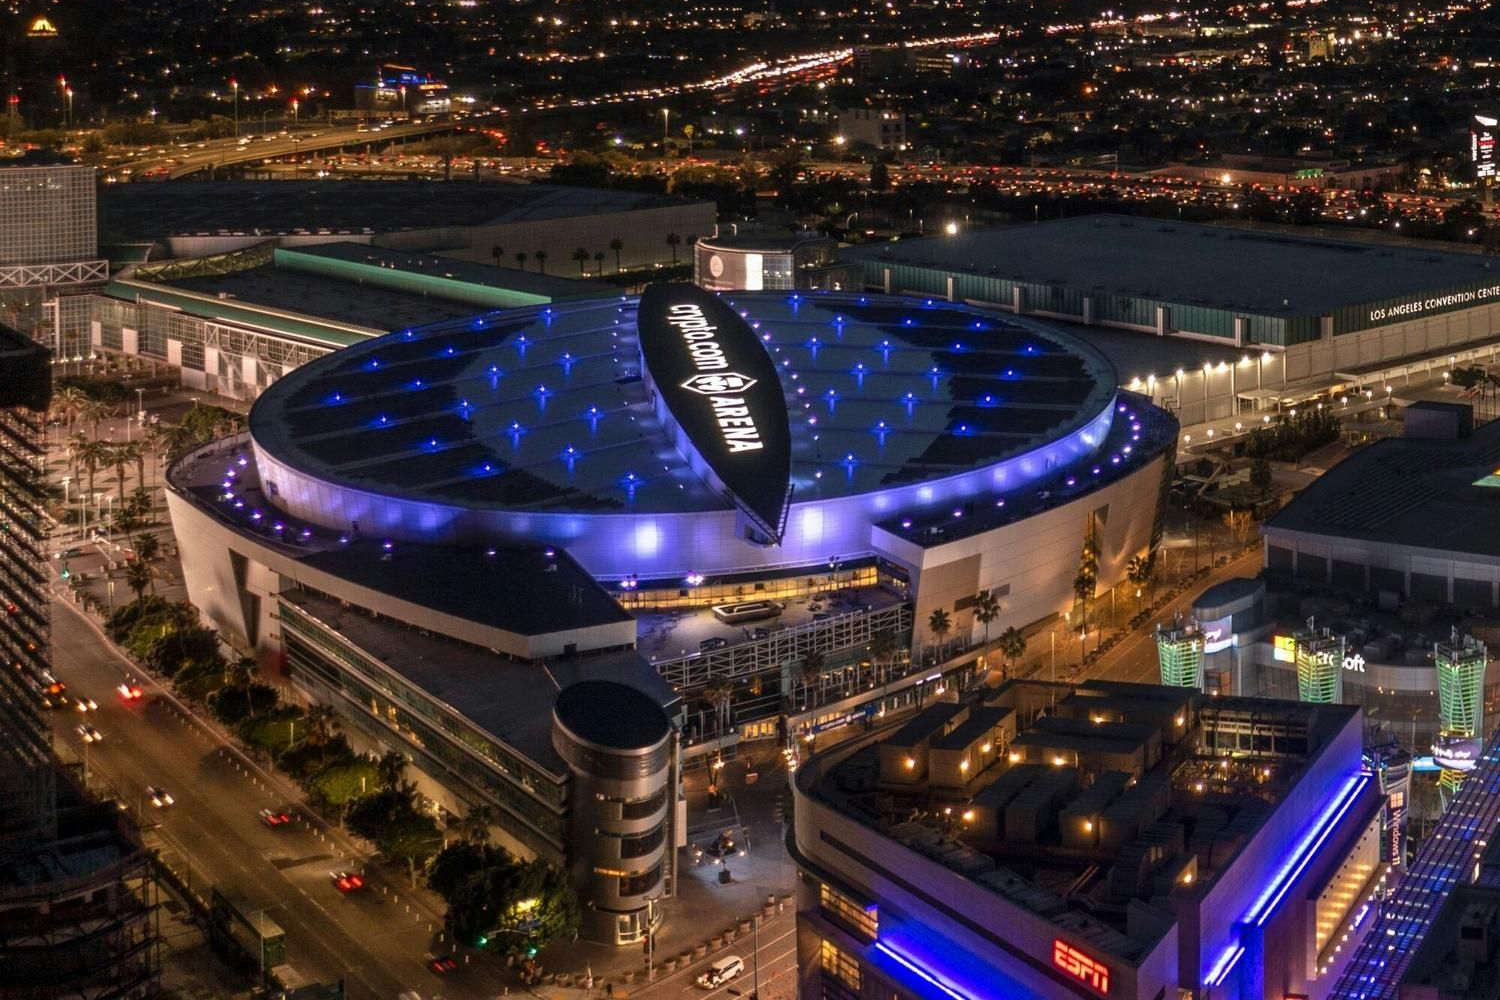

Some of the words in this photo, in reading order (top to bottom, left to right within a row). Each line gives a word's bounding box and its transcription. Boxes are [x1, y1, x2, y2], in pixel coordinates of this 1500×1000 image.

[1370, 309, 1385, 321] LOS
[1387, 301, 1423, 317] ANGELES
[1424, 290, 1475, 310] CONVENTION
[668, 304, 728, 370] crypto.com
[709, 396, 764, 452] ARENA
[1392, 809, 1401, 858] Windows
[1055, 940, 1108, 993] ESPN
